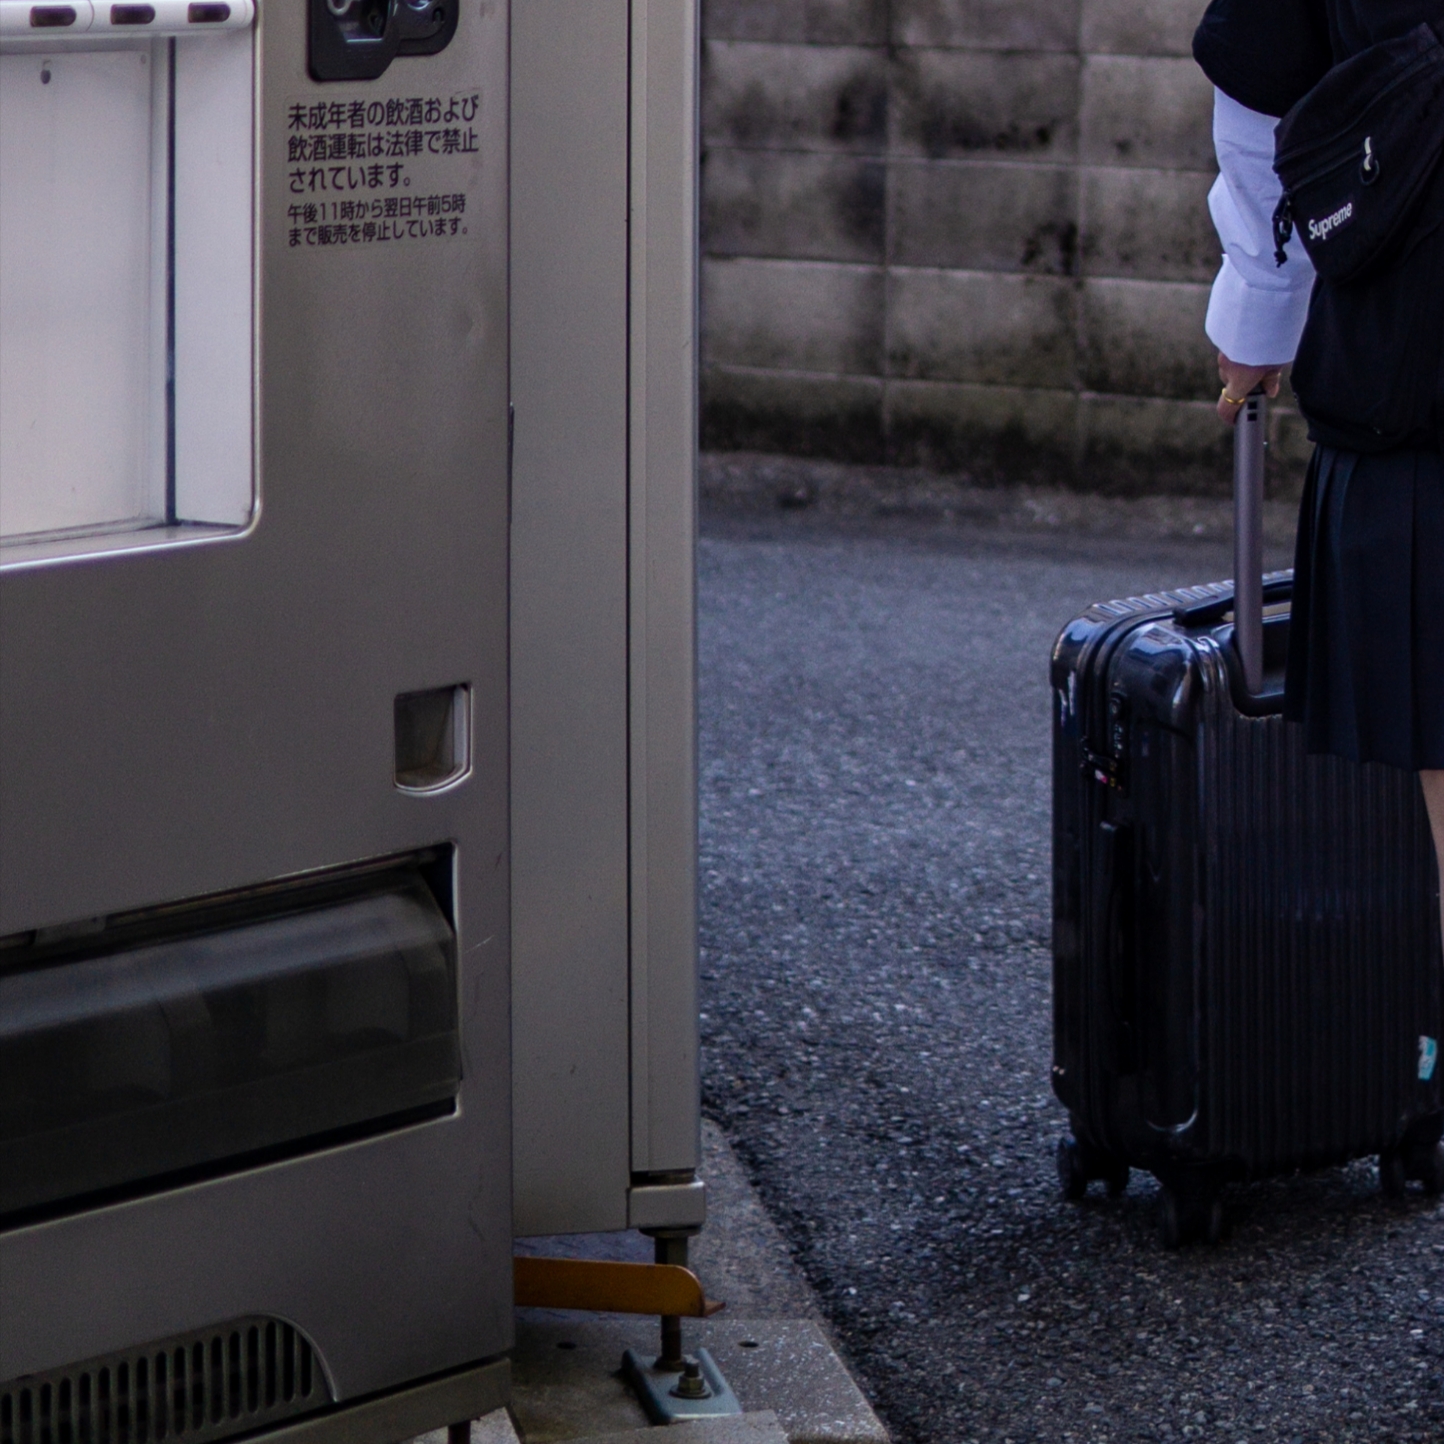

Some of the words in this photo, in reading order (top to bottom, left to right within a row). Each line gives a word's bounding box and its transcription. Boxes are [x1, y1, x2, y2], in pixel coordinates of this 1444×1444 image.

[288, 94, 479, 131] 未成年者の飲酒および
[287, 127, 479, 162] 飲酒運転は法律で禁止
[289, 162, 411, 193] されています。
[287, 193, 466, 224] 午後11時から翌日午前5時
[1308, 202, 1352, 240] Supreme
[288, 216, 469, 248] まで販売を停止しています。
